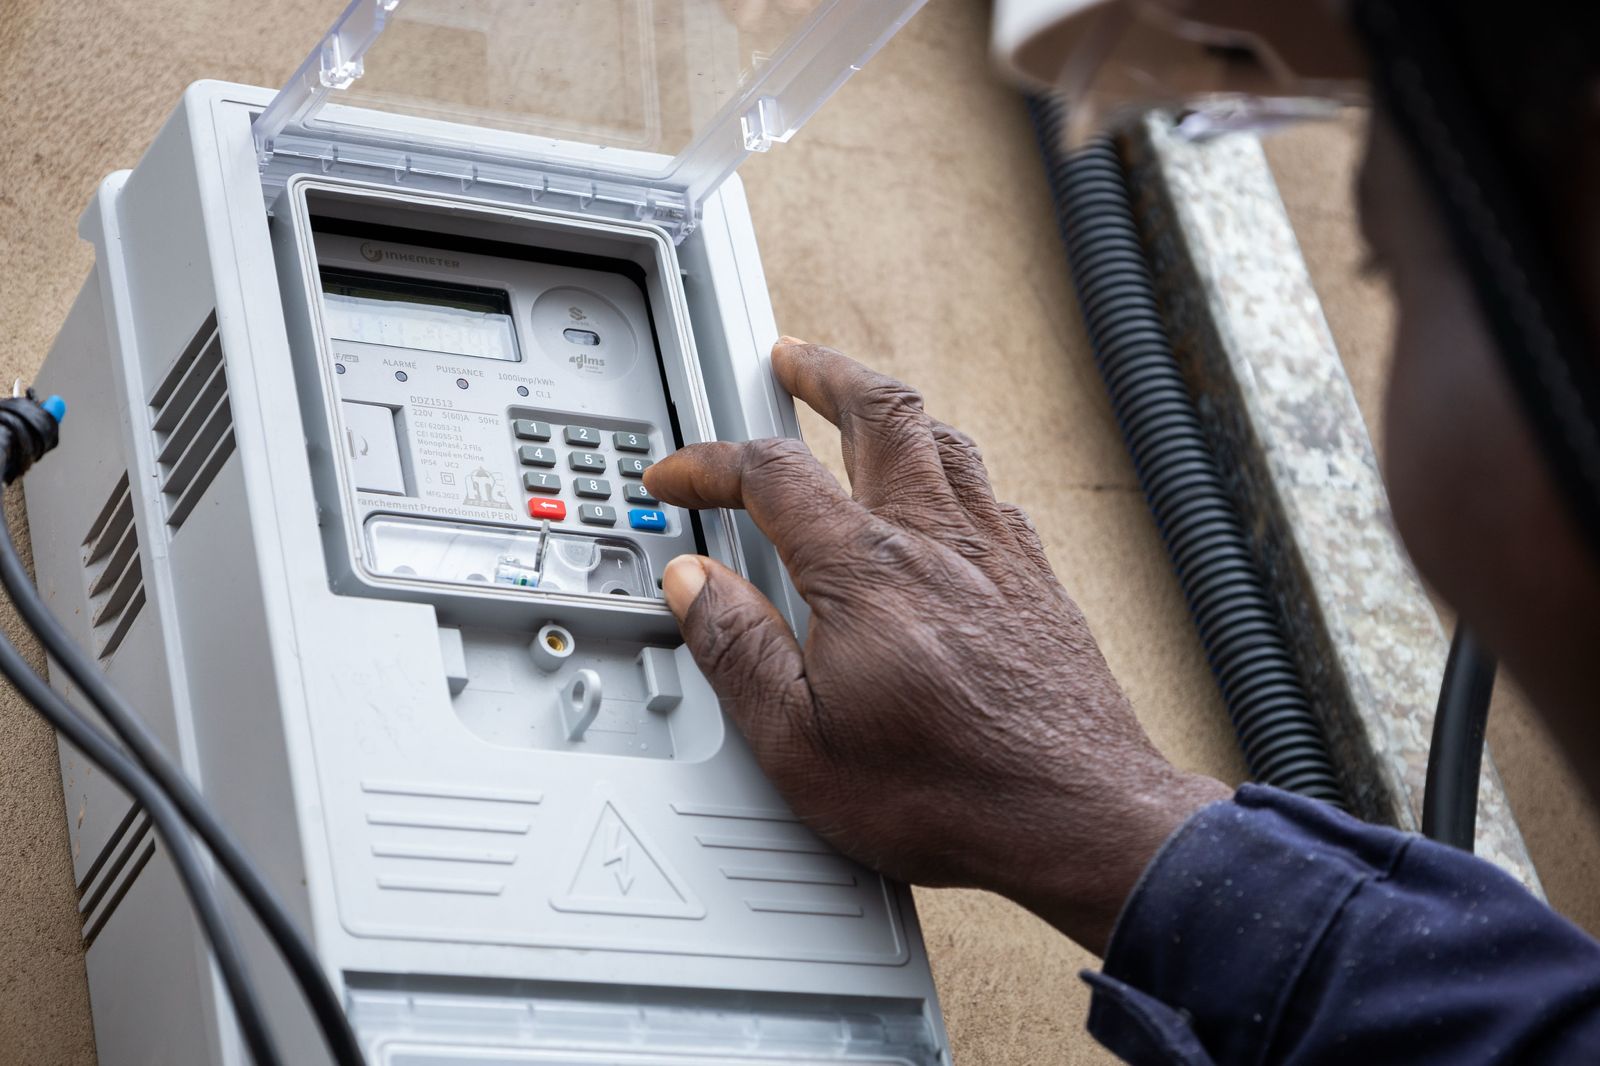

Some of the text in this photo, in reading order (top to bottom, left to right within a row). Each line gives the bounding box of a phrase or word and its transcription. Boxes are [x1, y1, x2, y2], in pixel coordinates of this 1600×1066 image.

[383, 358, 417, 370] ALARME
[436, 365, 485, 377] PUISSANCE
[410, 395, 454, 408] DDZ1513
[412, 408, 433, 417] 220V
[478, 416, 500, 426] 50Hz
[530, 422, 538, 433] 1
[579, 428, 588, 440] 2
[628, 434, 637, 445] 3
[534, 448, 544, 459] 4
[584, 454, 593, 465] 5
[634, 460, 642, 470] 6
[538, 474, 547, 485] 7
[590, 480, 598, 491] 8
[639, 486, 648, 496] 9
[421, 504, 491, 519] Promotionnel
[491, 511, 519, 522] PERU
[594, 506, 603, 517] 0
